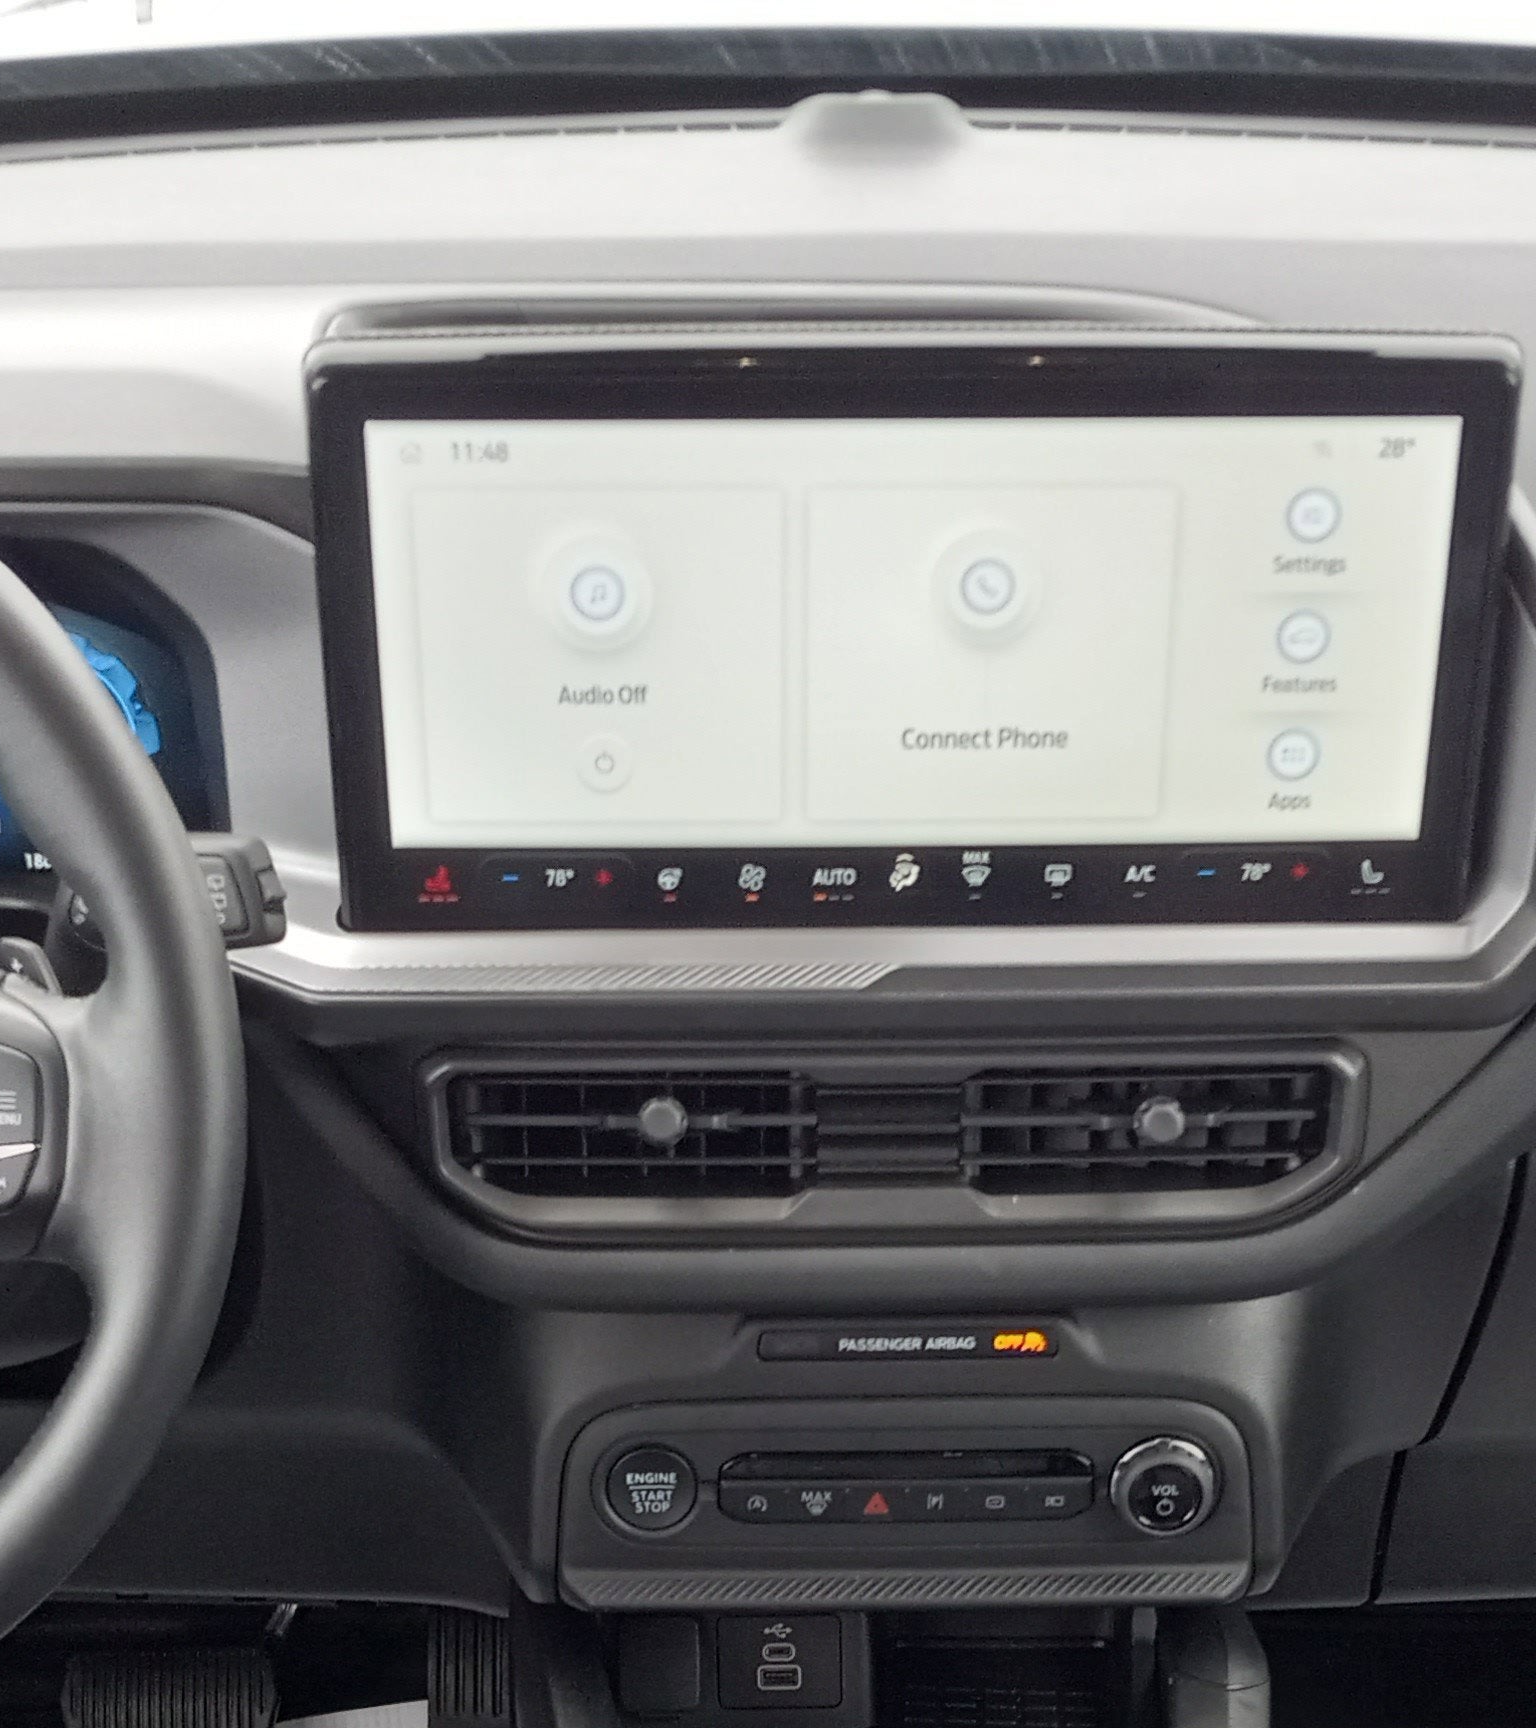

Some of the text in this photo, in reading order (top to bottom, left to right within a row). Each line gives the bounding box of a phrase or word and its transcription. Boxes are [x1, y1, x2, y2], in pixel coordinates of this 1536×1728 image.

[450, 442, 509, 463] 11:48
[1273, 556, 1347, 576] Settings
[1262, 676, 1337, 693] Features
[558, 685, 647, 705] Audio Off
[901, 727, 1068, 750] Connect Phone
[1268, 793, 1312, 811] Apps
[813, 868, 856, 886] AUTO
[1124, 865, 1156, 883] A/C
[838, 1337, 922, 1351] PASSENGER
[924, 1336, 976, 1350] AIRBAG
[626, 1472, 677, 1485] ENGINE
[632, 1491, 672, 1502] START
[801, 1491, 832, 1502] MAX
[1152, 1485, 1179, 1496] VOL
[635, 1502, 670, 1513] STOP
